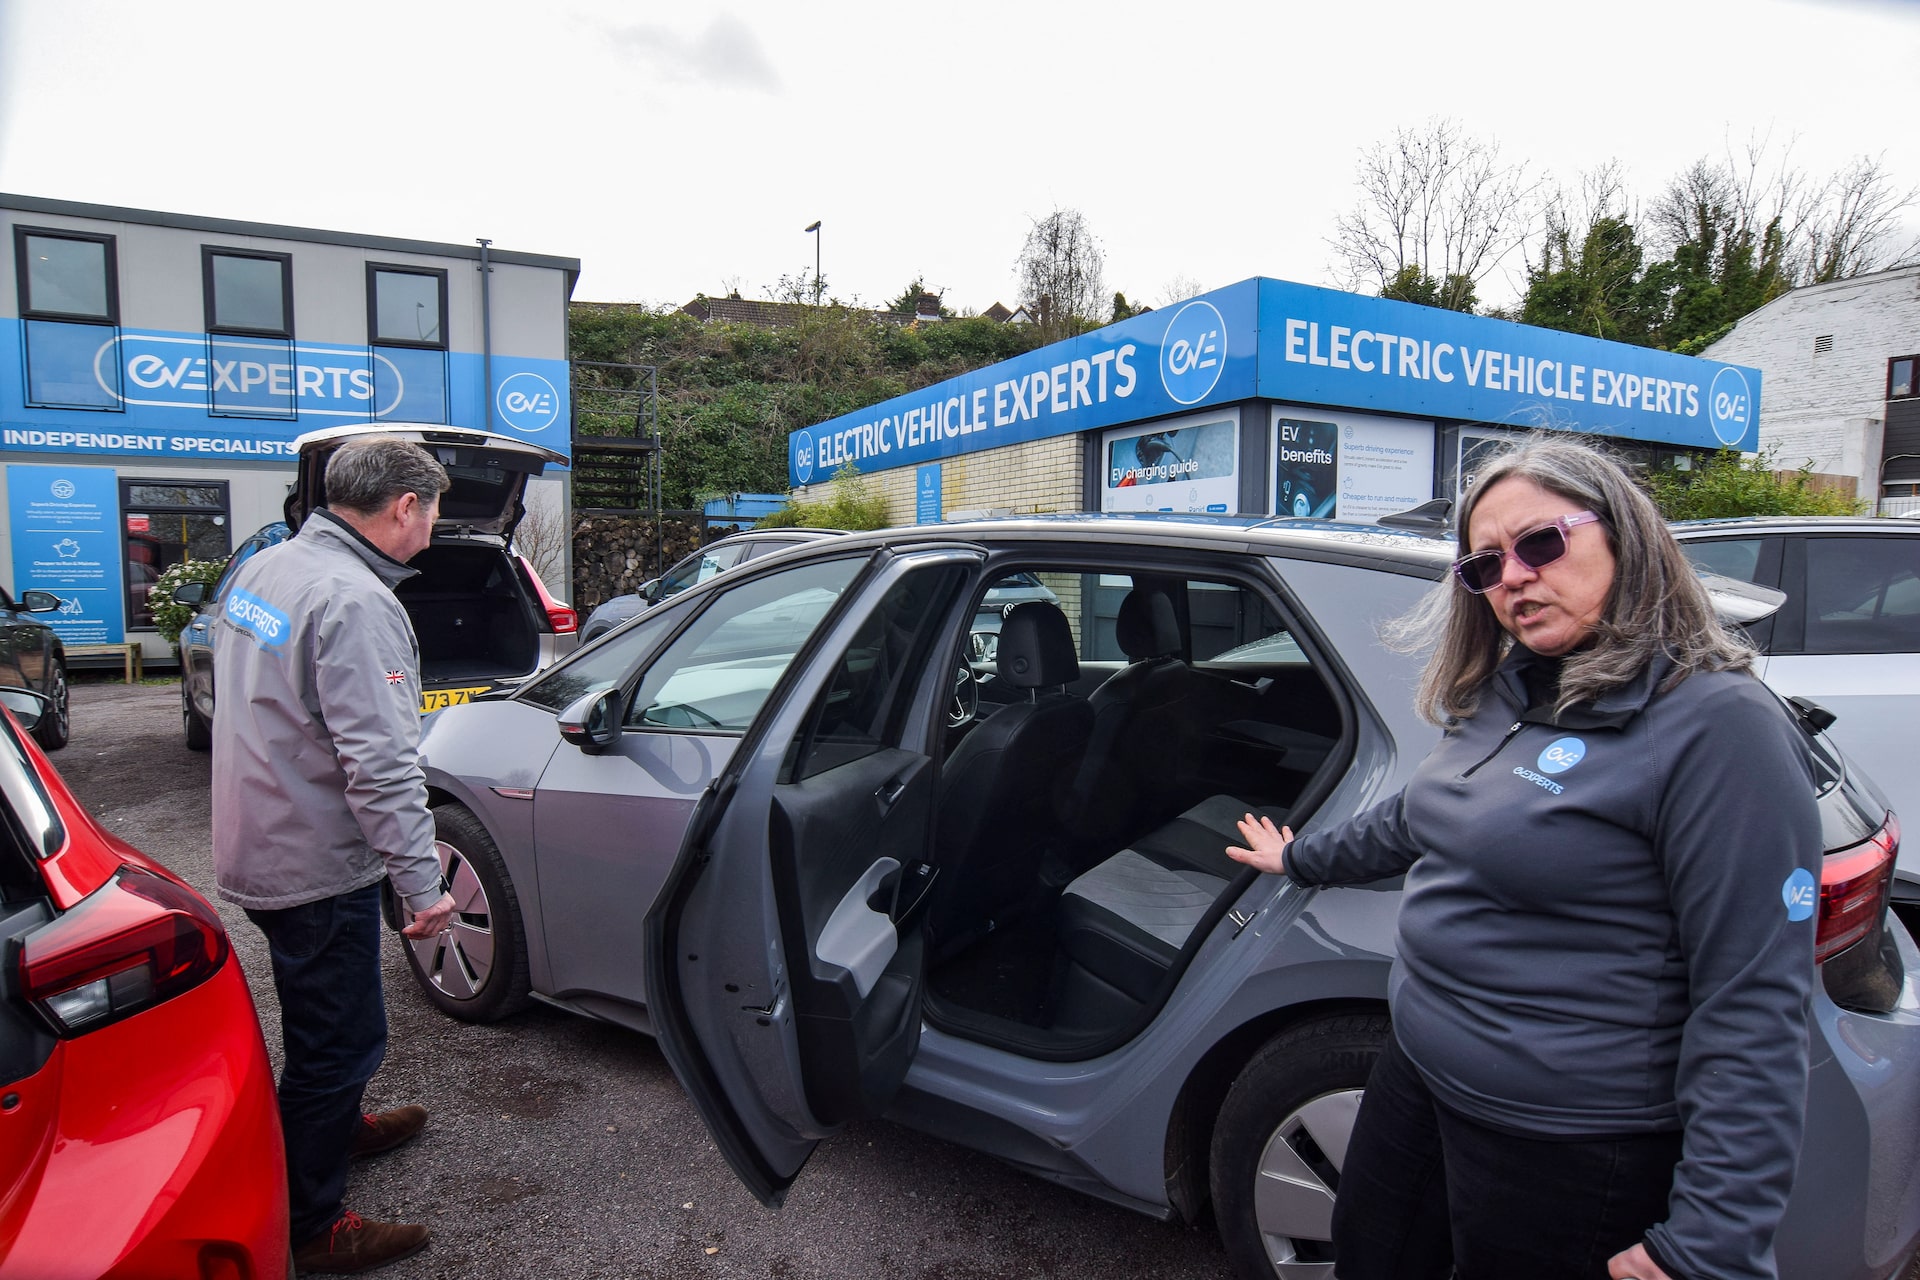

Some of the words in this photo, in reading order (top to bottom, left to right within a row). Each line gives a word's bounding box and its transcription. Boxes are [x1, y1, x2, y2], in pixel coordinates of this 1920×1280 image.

[1285, 318, 1454, 383] ELECTRIC
[1460, 346, 1584, 402] VEHICLE
[1592, 369, 1699, 417] EXPERTS
[819, 417, 891, 469] ELECTRIC
[894, 387, 986, 450] VEHICLE
[994, 344, 1136, 428] EXPERTS
[4, 429, 166, 450] INDEPENDENT
[171, 437, 297, 456] SPECIALISTS
[1281, 426, 1299, 441] EV
[1281, 446, 1332, 465] benefits
[1343, 443, 1364, 452] Superb
[1365, 445, 1384, 454] driving
[1385, 447, 1414, 456] experience
[1112, 467, 1124, 481] EV
[1126, 463, 1167, 480] charging
[1169, 459, 1199, 477] guide
[1342, 492, 1366, 502] Cheaper
[1367, 493, 1373, 501] to
[1396, 496, 1418, 504] maintain
